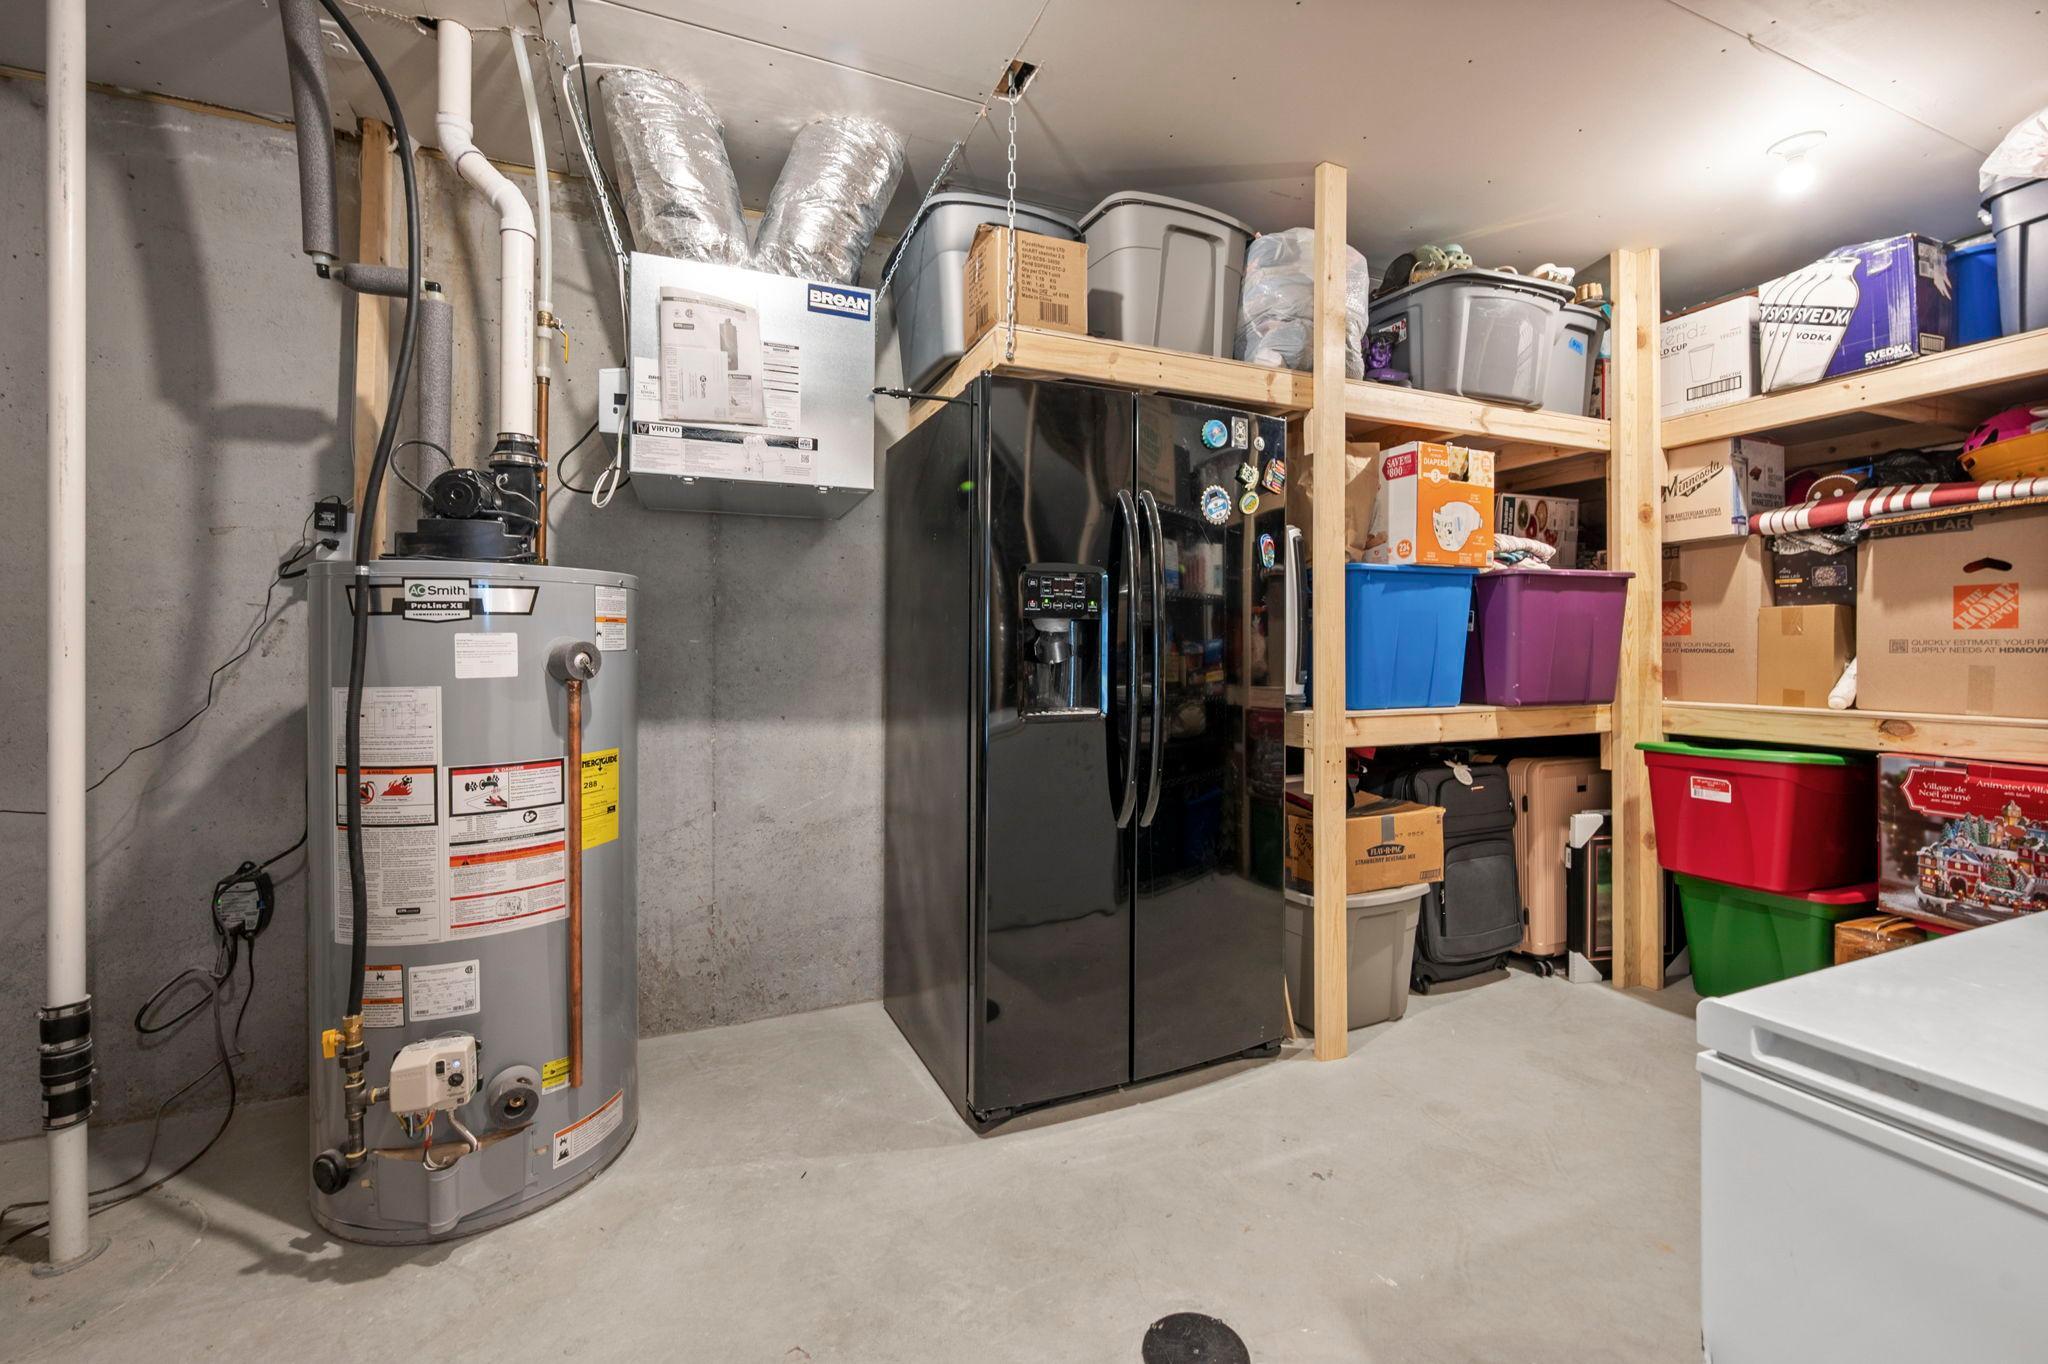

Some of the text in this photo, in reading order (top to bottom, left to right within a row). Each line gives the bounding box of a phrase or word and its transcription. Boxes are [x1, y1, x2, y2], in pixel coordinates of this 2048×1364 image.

[810, 289, 869, 311] BROAN
[1796, 332, 1832, 342] VODKA
[1670, 343, 1688, 353] CUP
[1864, 343, 1912, 360] SVEDKA
[651, 424, 680, 434] VIRTUO
[1386, 456, 1405, 469] SAVE
[1423, 457, 1449, 467] DIAPERS
[1387, 466, 1403, 478] $800
[1661, 460, 1720, 504] Minnesota
[1664, 513, 1675, 521] NEW
[1675, 509, 1704, 519] AMSTERDAM
[1704, 506, 1722, 515] VODKA
[1869, 522, 1928, 538] EXTRA
[1959, 588, 1986, 608] THE
[1953, 583, 2018, 629] HOME
[1978, 600, 2019, 629] DEPOT
[1911, 639, 1951, 647] QUICKLY
[2003, 638, 2035, 646] YOUR
[1911, 646, 1947, 654] SUPPLY
[1922, 781, 1967, 794] Village de
[1976, 779, 2026, 792] Animated
[1918, 788, 1972, 802] Noël animé
[1354, 857, 1384, 866] STRAWBERRY
[1385, 855, 1407, 863] BEVERAGE
